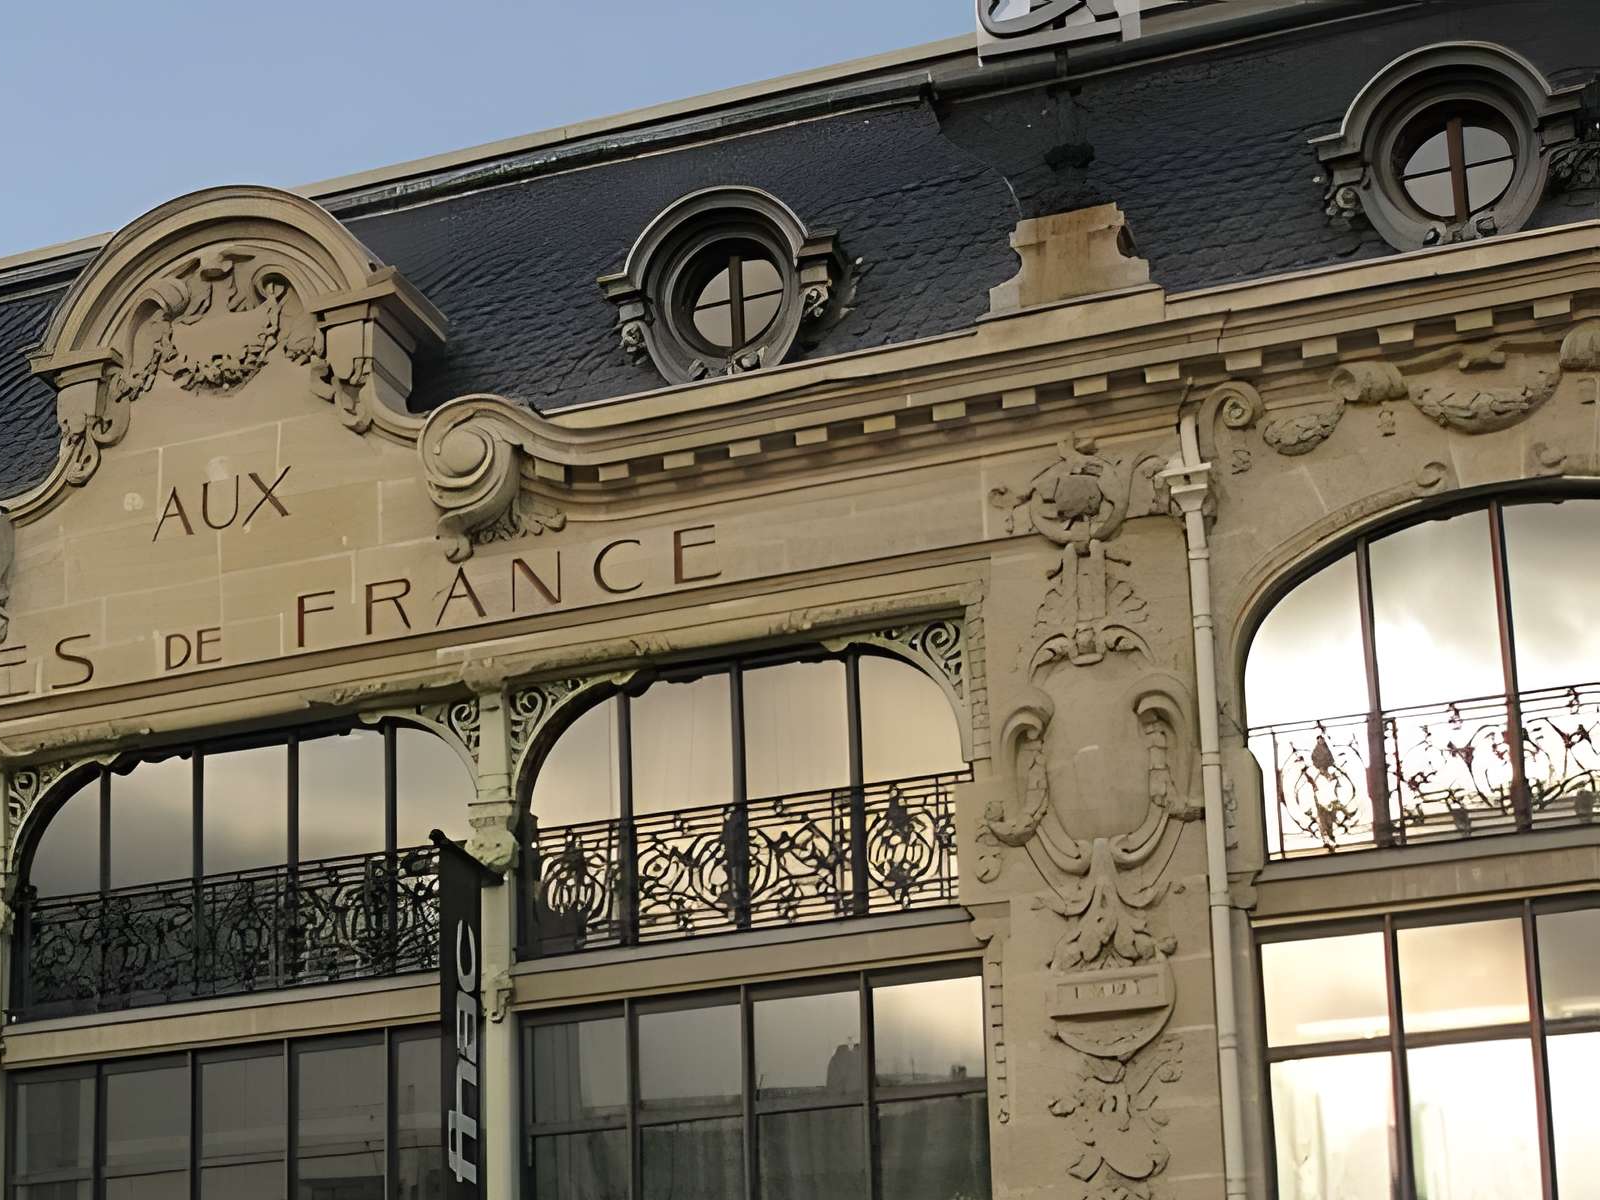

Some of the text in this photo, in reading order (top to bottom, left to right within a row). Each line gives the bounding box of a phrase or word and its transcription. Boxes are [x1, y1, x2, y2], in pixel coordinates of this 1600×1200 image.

[152, 464, 293, 543] AUX
[165, 626, 222, 671] DE
[296, 523, 723, 648] FRANCE
[448, 918, 478, 1185] fnac
